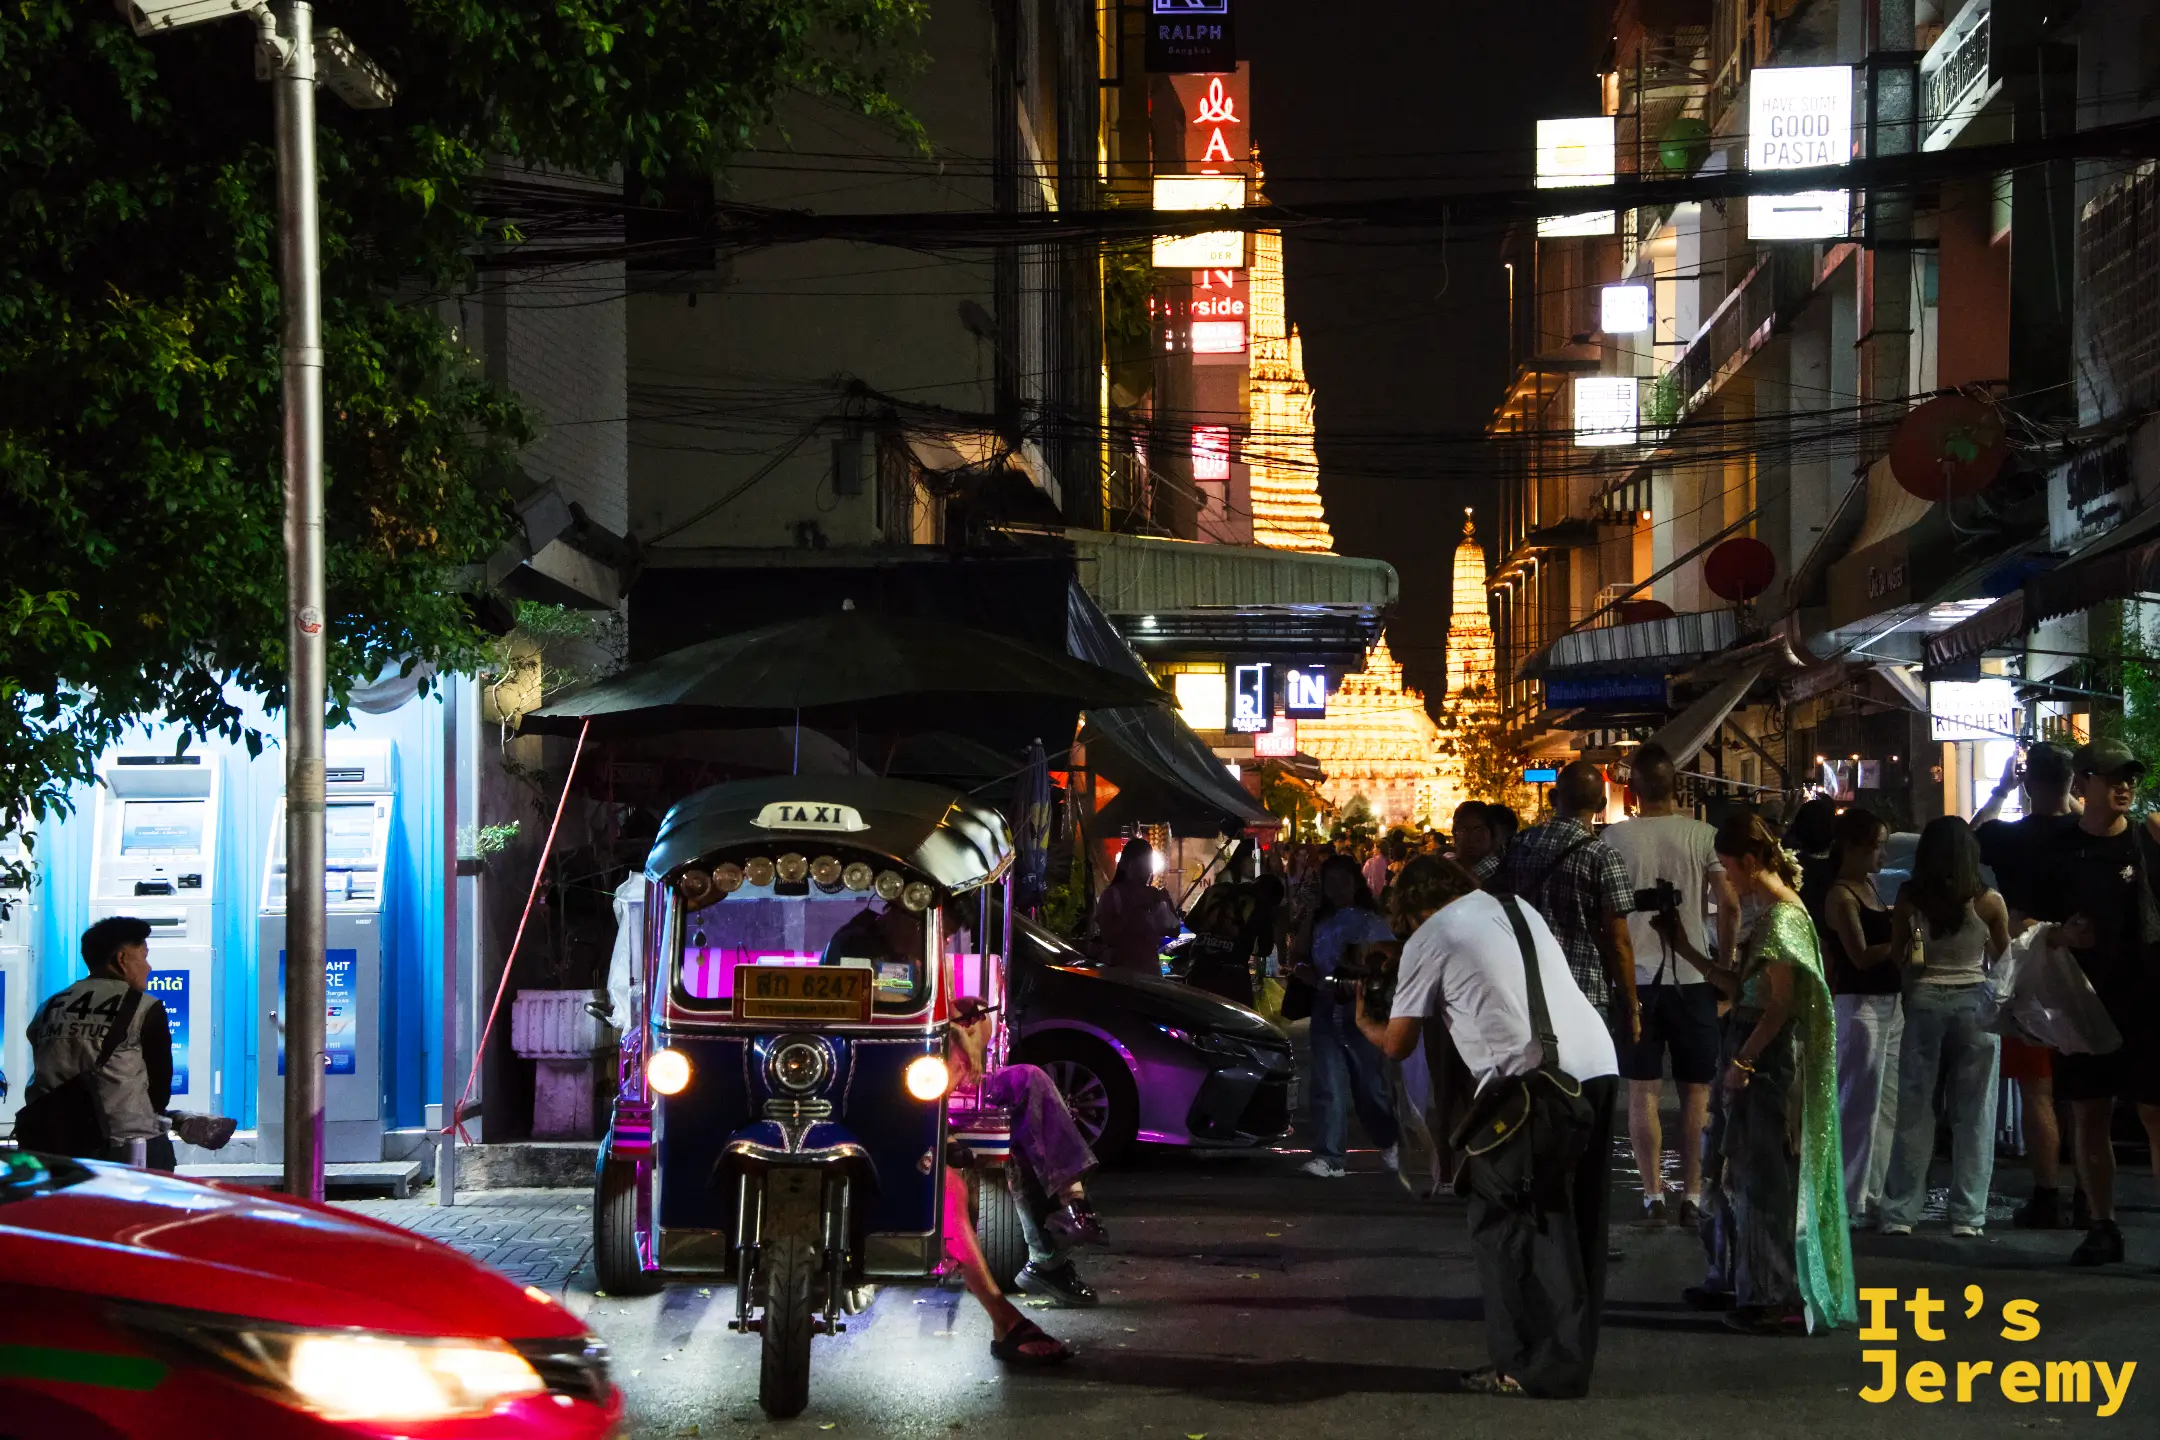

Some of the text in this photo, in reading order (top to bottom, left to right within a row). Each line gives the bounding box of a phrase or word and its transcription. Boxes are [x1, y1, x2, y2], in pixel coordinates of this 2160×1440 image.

[1159, 25, 1222, 40] RALPH
[1168, 46, 1211, 55] Bangkok
[1763, 95, 1837, 113] HAVE SOME
[1771, 115, 1829, 139] GOOD
[1763, 140, 1836, 165] PASTA!
[1936, 713, 2008, 732] KITCHEN
[778, 805, 841, 824] TAXI
[802, 975, 857, 997] 6247
